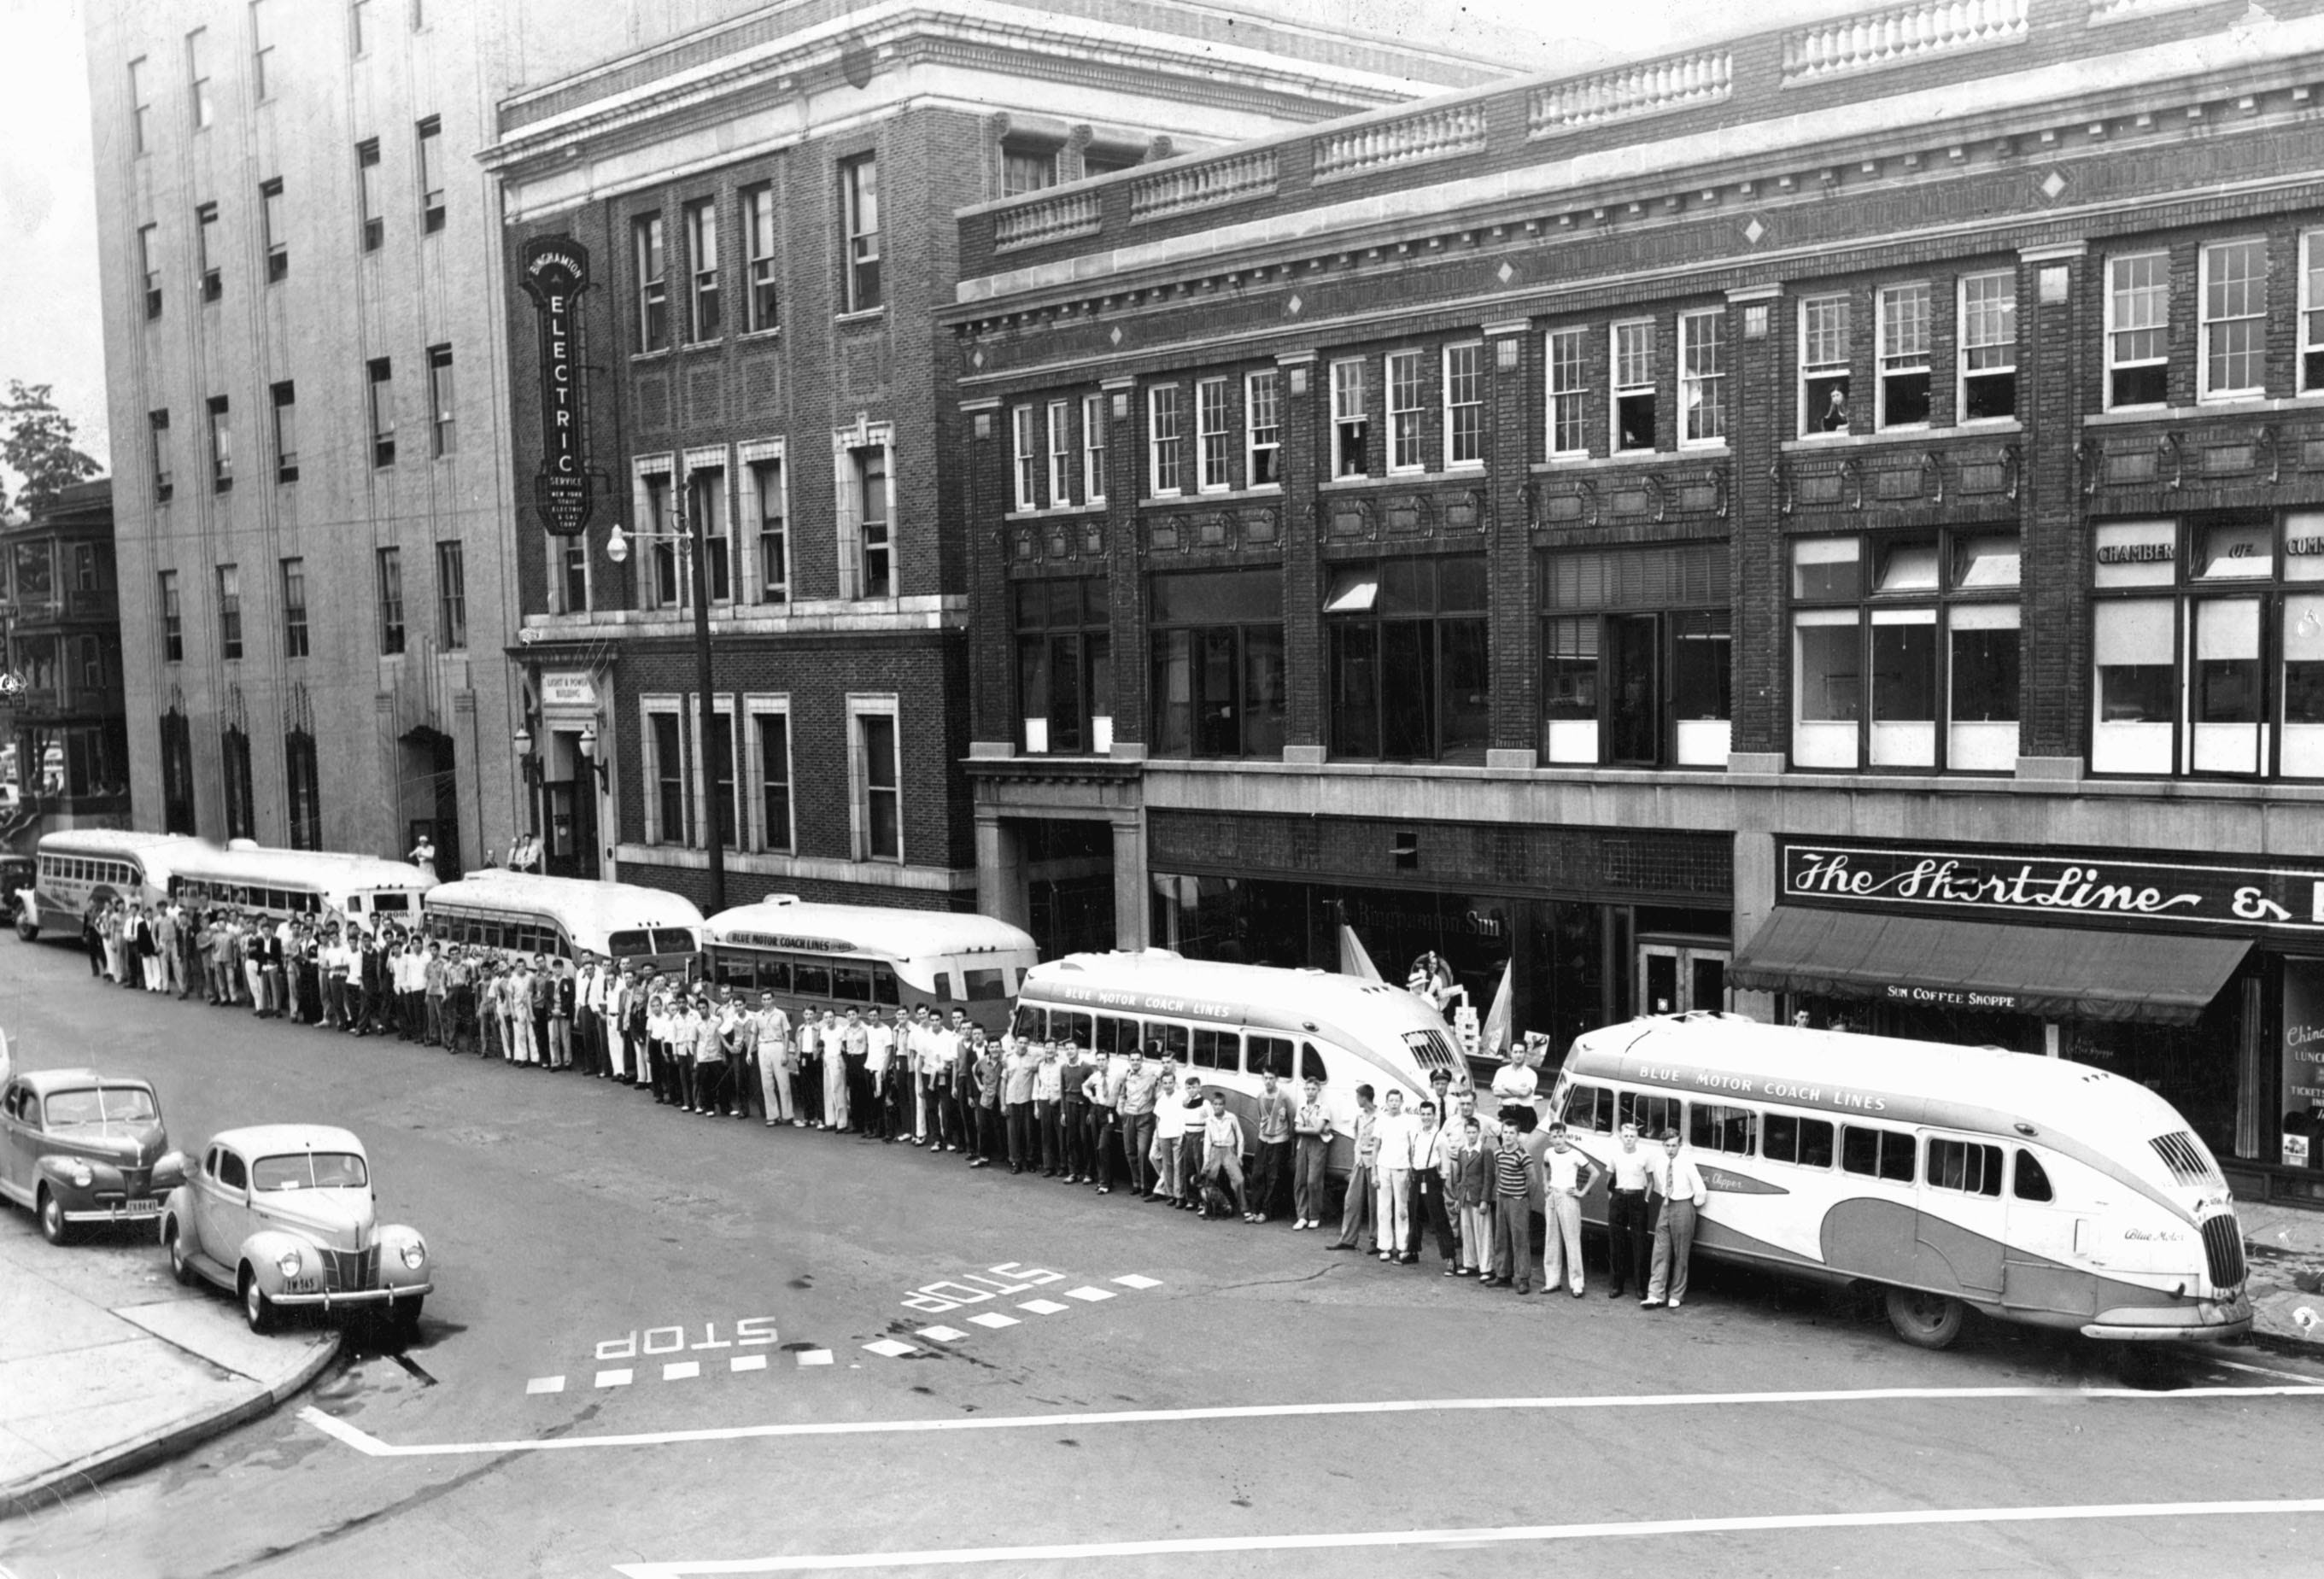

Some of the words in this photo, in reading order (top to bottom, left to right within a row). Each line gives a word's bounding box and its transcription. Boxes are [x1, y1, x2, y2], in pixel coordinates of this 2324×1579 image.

[530, 253, 582, 278] BINGHAMTON
[551, 296, 572, 471] ELECTRIC
[550, 477, 582, 486] SERVICE
[2097, 543, 2175, 564] CHAMBER
[2228, 543, 2255, 558] OF
[1795, 854, 1894, 895] The
[2232, 886, 2292, 921] &
[1466, 909, 1500, 937] Sun
[732, 933, 750, 944] BLUE
[752, 934, 778, 946] MOTOR
[780, 937, 805, 949] COACH
[807, 940, 830, 951] LINES
[1065, 987, 1092, 1001] BLUE
[1098, 991, 1137, 1007] MOTOR
[1144, 997, 1185, 1012] COACH
[1192, 1003, 1231, 1018] LINES
[1639, 1066, 1681, 1082] BLUE
[1695, 1073, 1752, 1092] MOTOR
[1764, 1082, 1821, 1102] COACH
[1834, 1091, 1887, 1110] LINES
[1712, 1173, 1742, 1190] Clipper
[2124, 1228, 2152, 1241] Blue
[900, 1261, 1068, 1313] STOP
[596, 1316, 779, 1360] STOP
